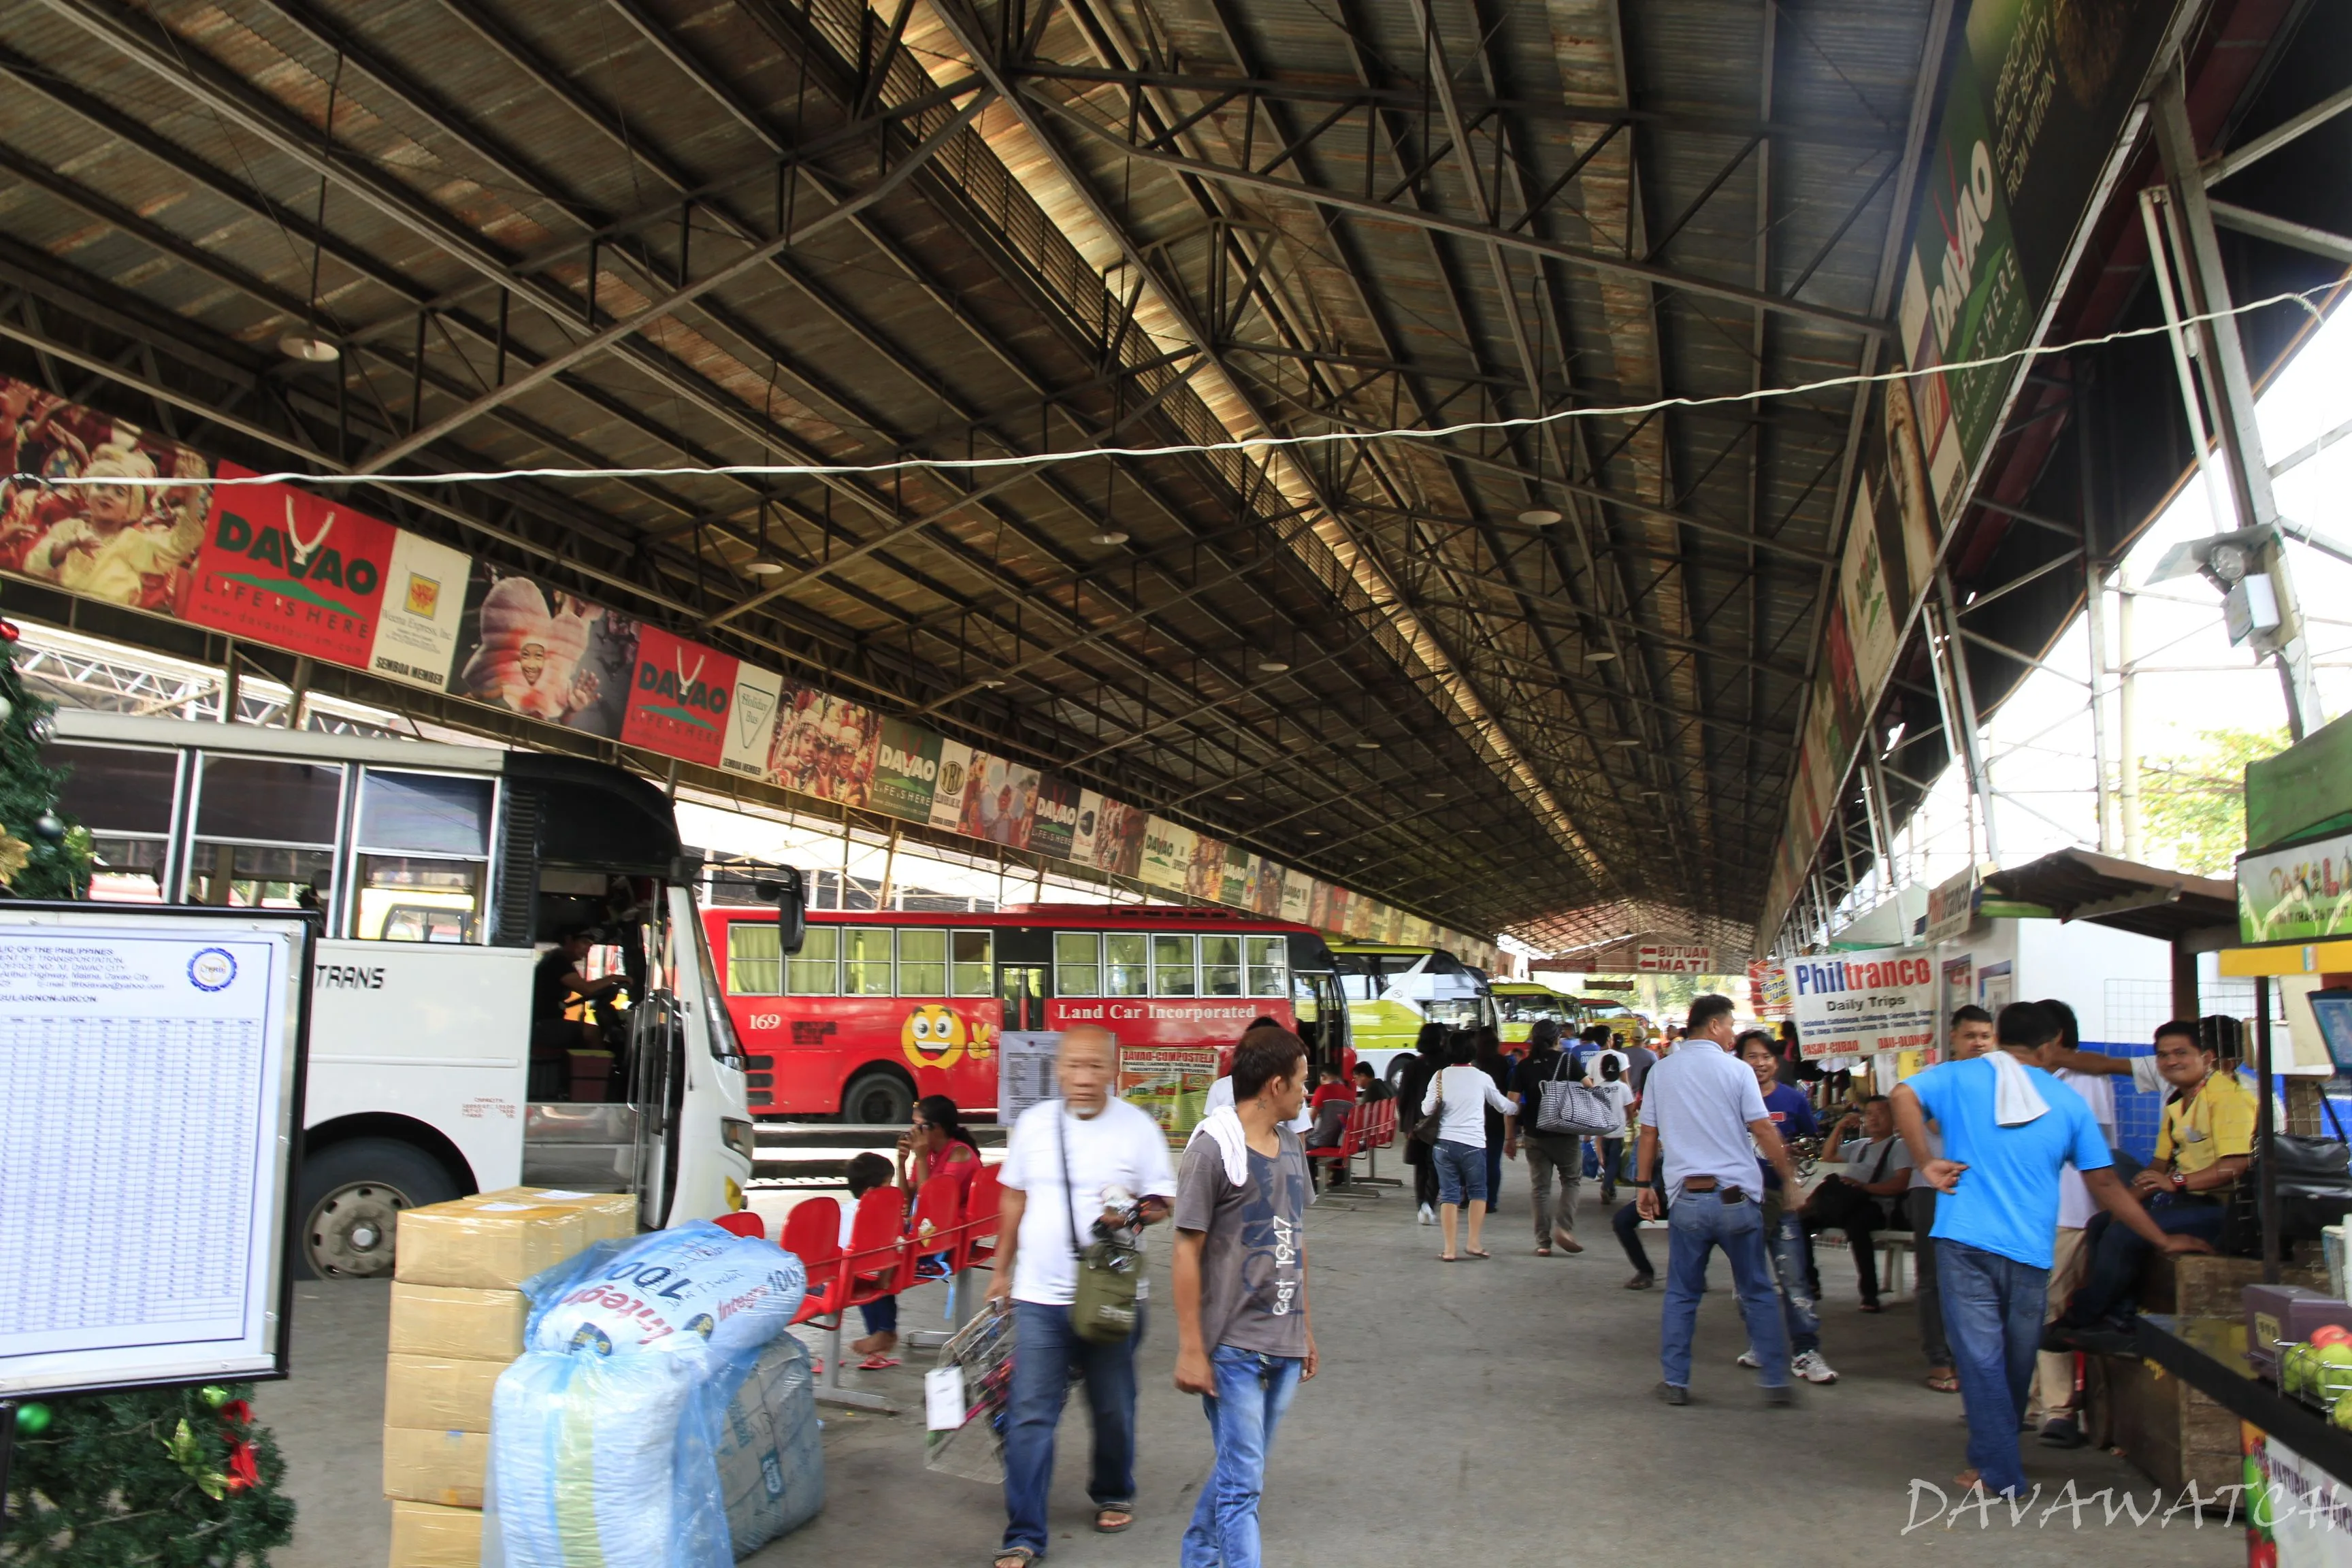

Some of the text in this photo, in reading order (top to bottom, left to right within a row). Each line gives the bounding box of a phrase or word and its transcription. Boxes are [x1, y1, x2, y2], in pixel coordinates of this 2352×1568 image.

[1997, 5, 2049, 175] EXOTIC BEAUTY
[2007, 58, 2056, 206] FROM WITHIN
[1931, 140, 1993, 355] DAVAO
[1983, 248, 2016, 340] HERE
[214, 510, 378, 595] DAVAO
[306, 607, 370, 640] HERE
[638, 661, 728, 715] DAVAO
[741, 692, 768, 712] Holiday
[746, 710, 758, 725] Bus
[686, 725, 722, 746] HERE
[879, 743, 936, 782] DAVAO
[907, 791, 932, 806] HERE
[1035, 796, 1077, 826] DAVAO
[1056, 833, 1073, 846] HERE
[1145, 834, 1174, 858] DAVAO
[1223, 862, 1246, 881] DAVAO
[54, 947, 114, 956] PHILIPPINES
[1658, 946, 1709, 959] BUTUAN
[1658, 959, 1708, 972] MATI
[314, 964, 387, 990] TRANS
[1794, 958, 1931, 996] Philtranco
[1058, 1004, 1258, 1023] Land Car Incorporated
[1826, 995, 1906, 1013] Daily Trips
[748, 1013, 781, 1030] 169
[1801, 1040, 1860, 1056] PASAY-CUBAO
[1273, 1215, 1296, 1268] 1947
